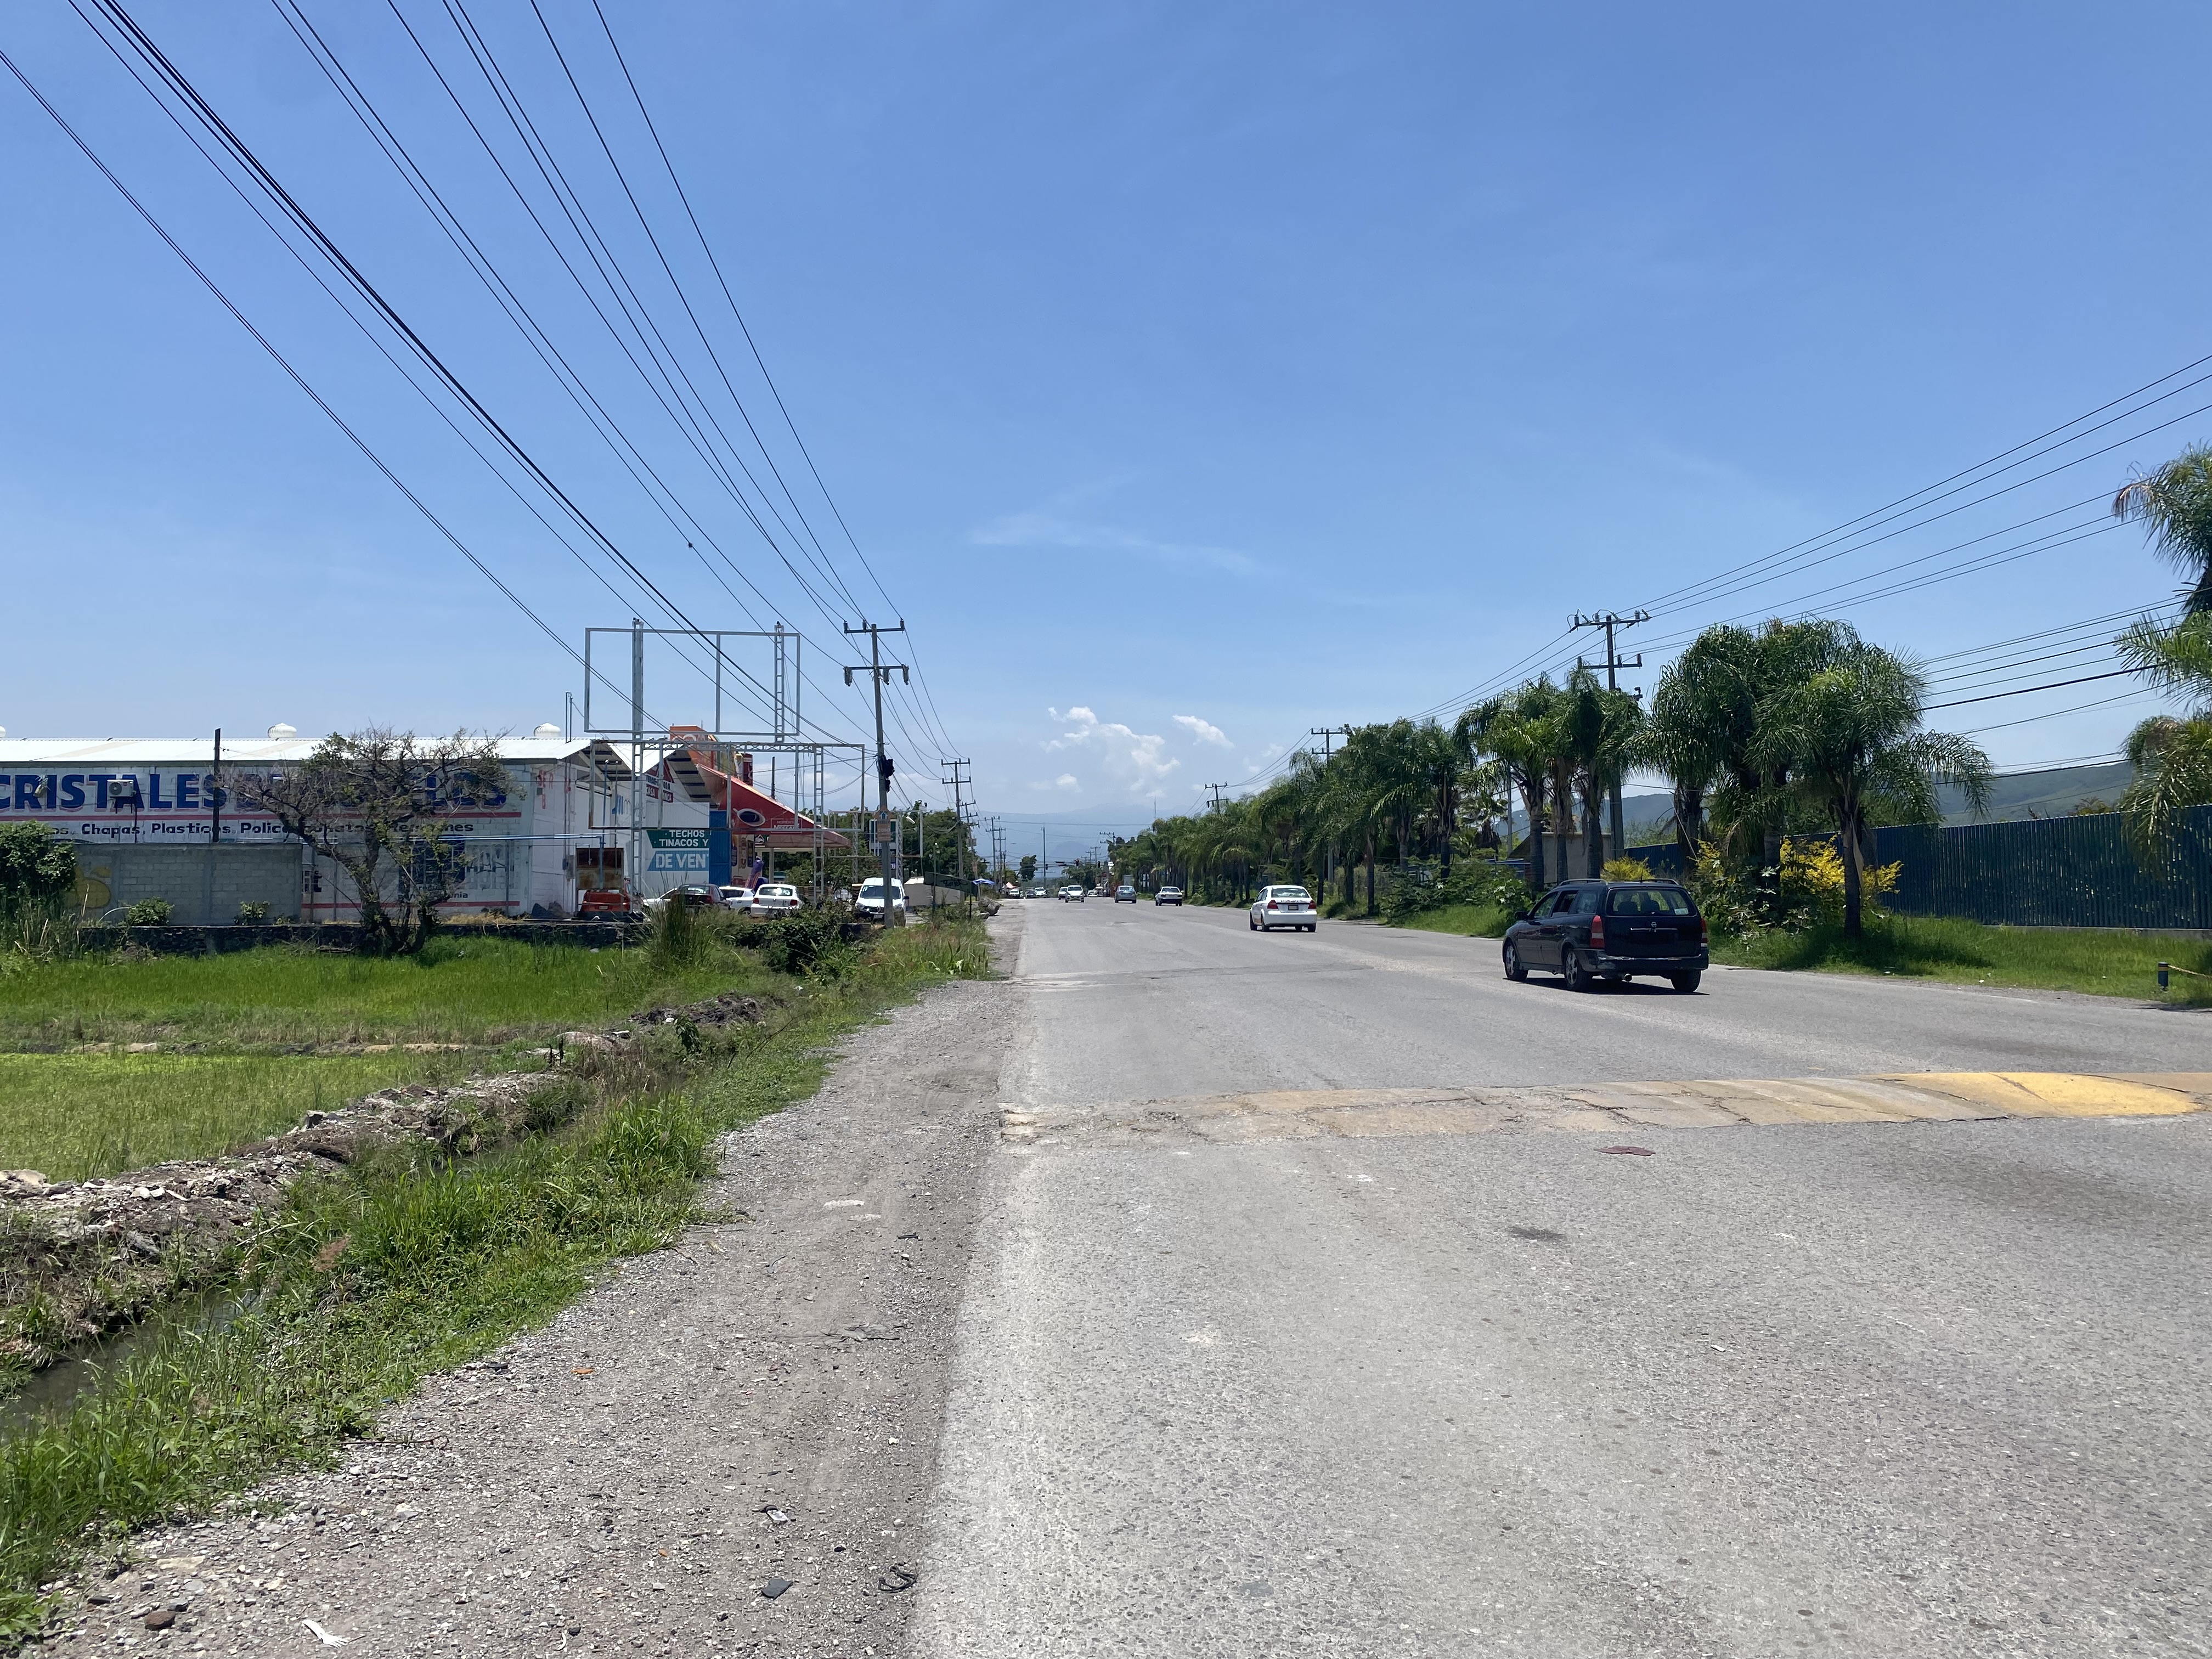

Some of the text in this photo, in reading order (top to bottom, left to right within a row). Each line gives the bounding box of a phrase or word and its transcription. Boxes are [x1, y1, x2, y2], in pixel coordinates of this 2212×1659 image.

[669, 830, 705, 838] TECHOS
[656, 854, 709, 868] DE VEN
